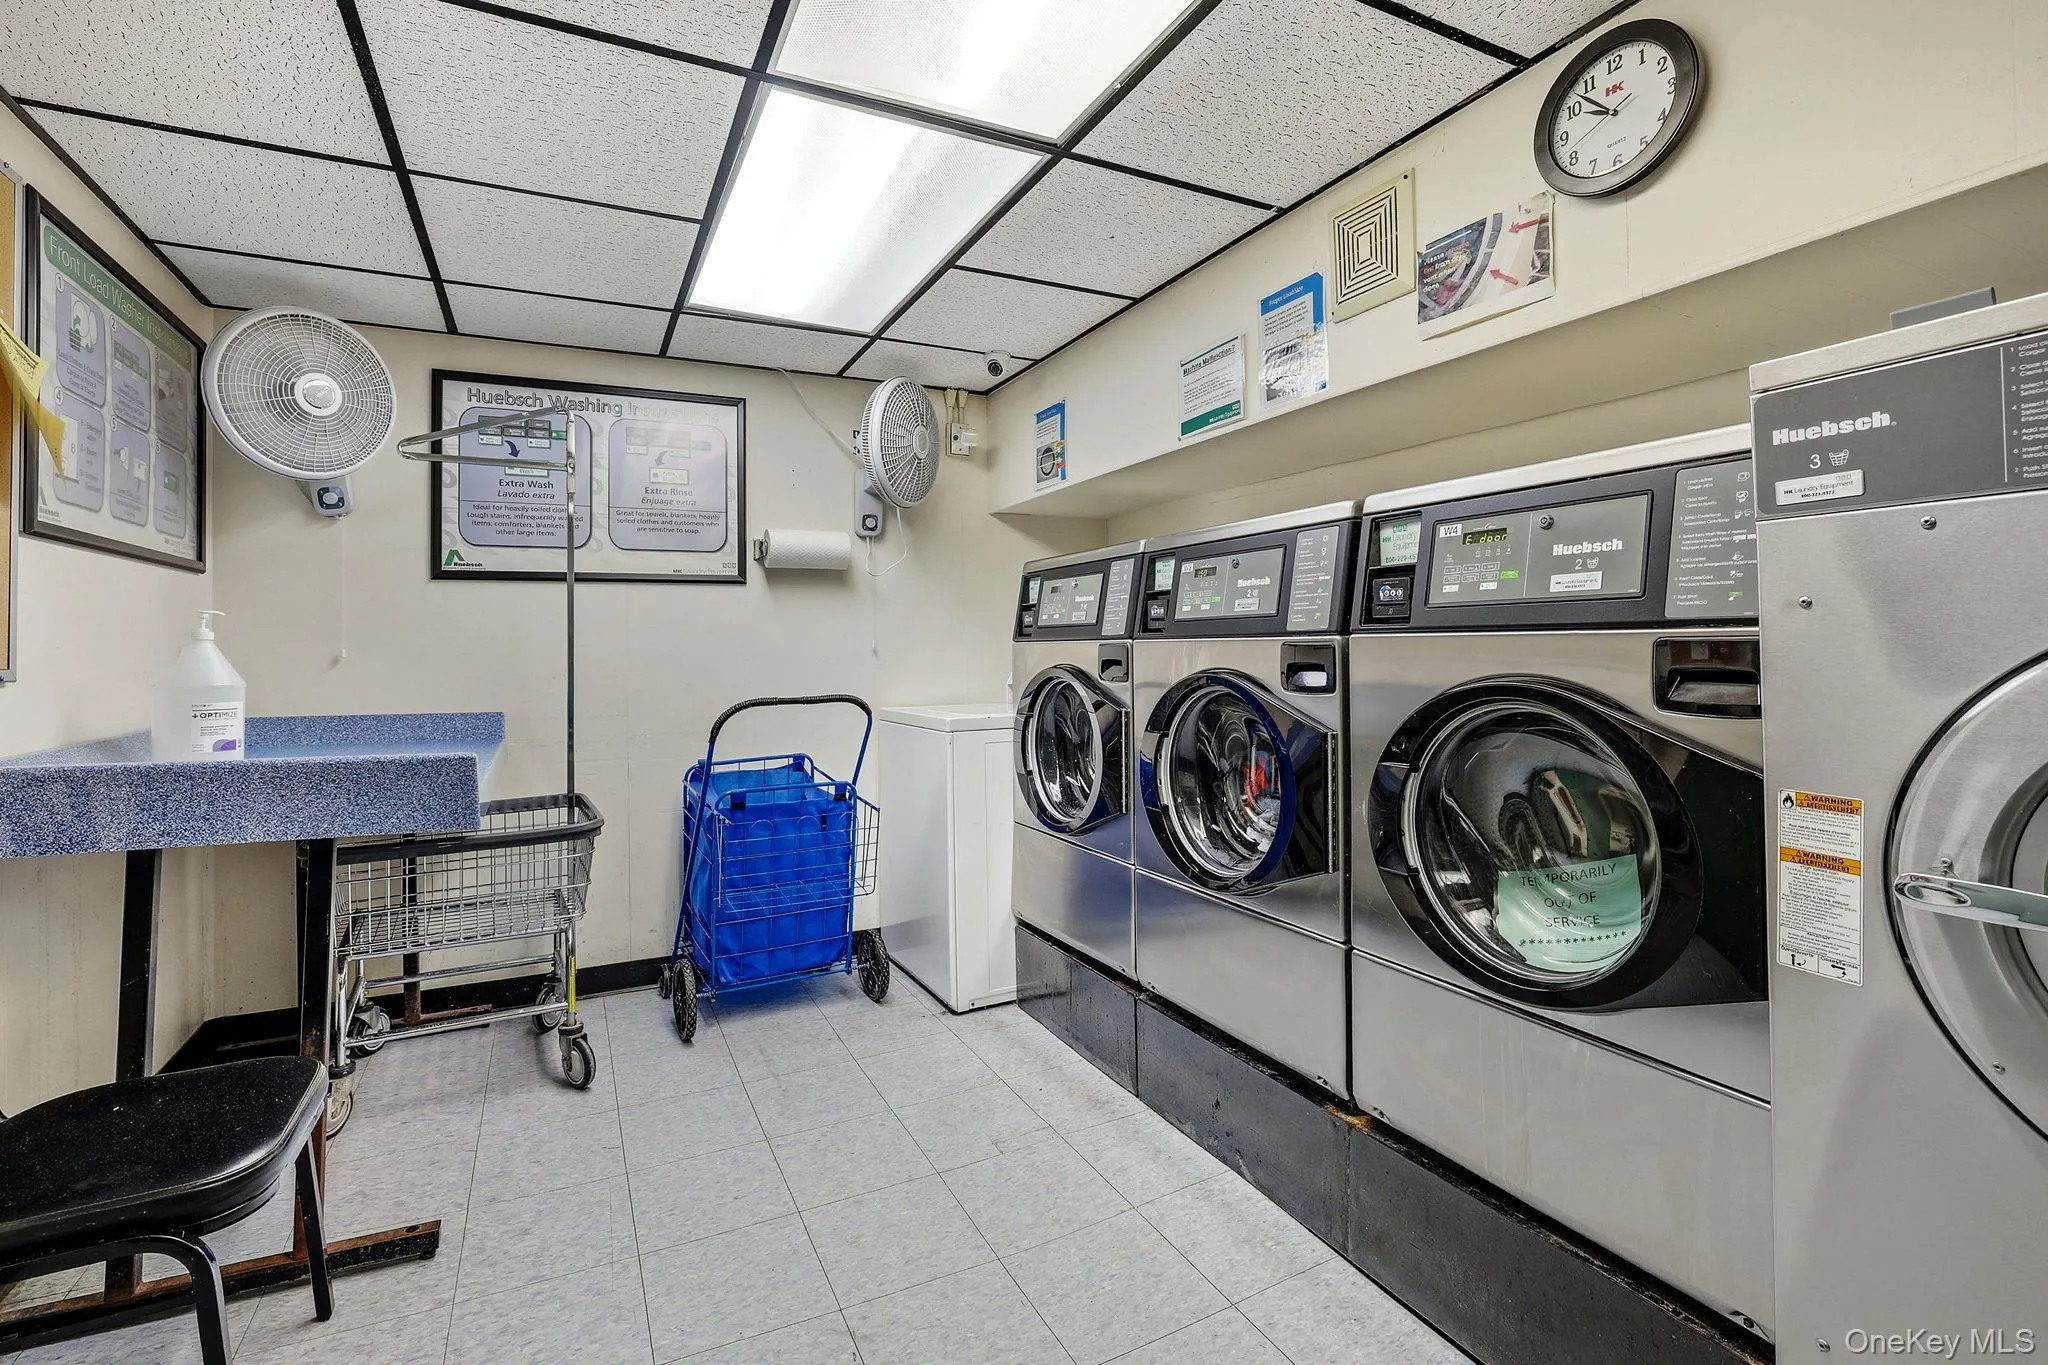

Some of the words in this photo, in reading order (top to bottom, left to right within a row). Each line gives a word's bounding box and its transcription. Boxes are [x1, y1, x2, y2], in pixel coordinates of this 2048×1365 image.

[1639, 49, 1646, 66] 1
[1606, 54, 1623, 75] 12
[1657, 56, 1668, 75] 2
[1583, 75, 1596, 95] 11
[1605, 81, 1624, 97] HK
[1667, 77, 1676, 95] 3
[1566, 101, 1582, 121] 10
[1657, 108, 1667, 126] 4
[1560, 131, 1569, 147] 9
[1607, 137, 1627, 148] QUARTZ
[1640, 136, 1650, 151] 5
[1569, 150, 1579, 167] 8
[1588, 158, 1598, 175] 7
[50, 235, 80, 276] Front
[83, 262, 109, 299] Load
[112, 286, 145, 328] Washer
[2018, 342, 2038, 350] Load
[2019, 362, 2041, 370] Close
[2020, 381, 2044, 390] Select
[56, 388, 61, 403] 4
[467, 387, 544, 408] Huebsch
[548, 395, 623, 417] Washing
[2021, 400, 2045, 409] Select
[112, 417, 116, 430] 5
[1772, 411, 1891, 446] Huebsch
[2022, 445, 2043, 453] Insert
[1809, 454, 1821, 469] 3
[499, 479, 525, 488] Extra
[528, 480, 554, 489] Wash
[1820, 481, 1854, 490] Equipment
[497, 490, 530, 499] Lavado
[532, 491, 555, 500] extra
[644, 486, 668, 495] Extra
[669, 487, 693, 496] Rinse
[504, 505, 529, 513] heavily
[615, 509, 635, 517] Great
[670, 512, 698, 520] blankets,
[698, 513, 721, 521] heavily
[467, 512, 489, 520] tough
[513, 514, 557, 522] infrequently
[558, 515, 584, 523] waed
[471, 519, 493, 527] items,
[494, 521, 535, 529] comforters,
[1444, 526, 1458, 536] W4
[1465, 535, 1472, 545] E
[1480, 533, 1507, 543] door
[1552, 538, 1623, 556] Huebsch
[1575, 559, 1583, 570] 2
[1246, 589, 1253, 598] 2
[1810, 795, 1853, 807] WARNING
[1801, 851, 1845, 865] WARNING
[1578, 891, 1597, 904] OF
[1545, 914, 1600, 928] SERVICE
